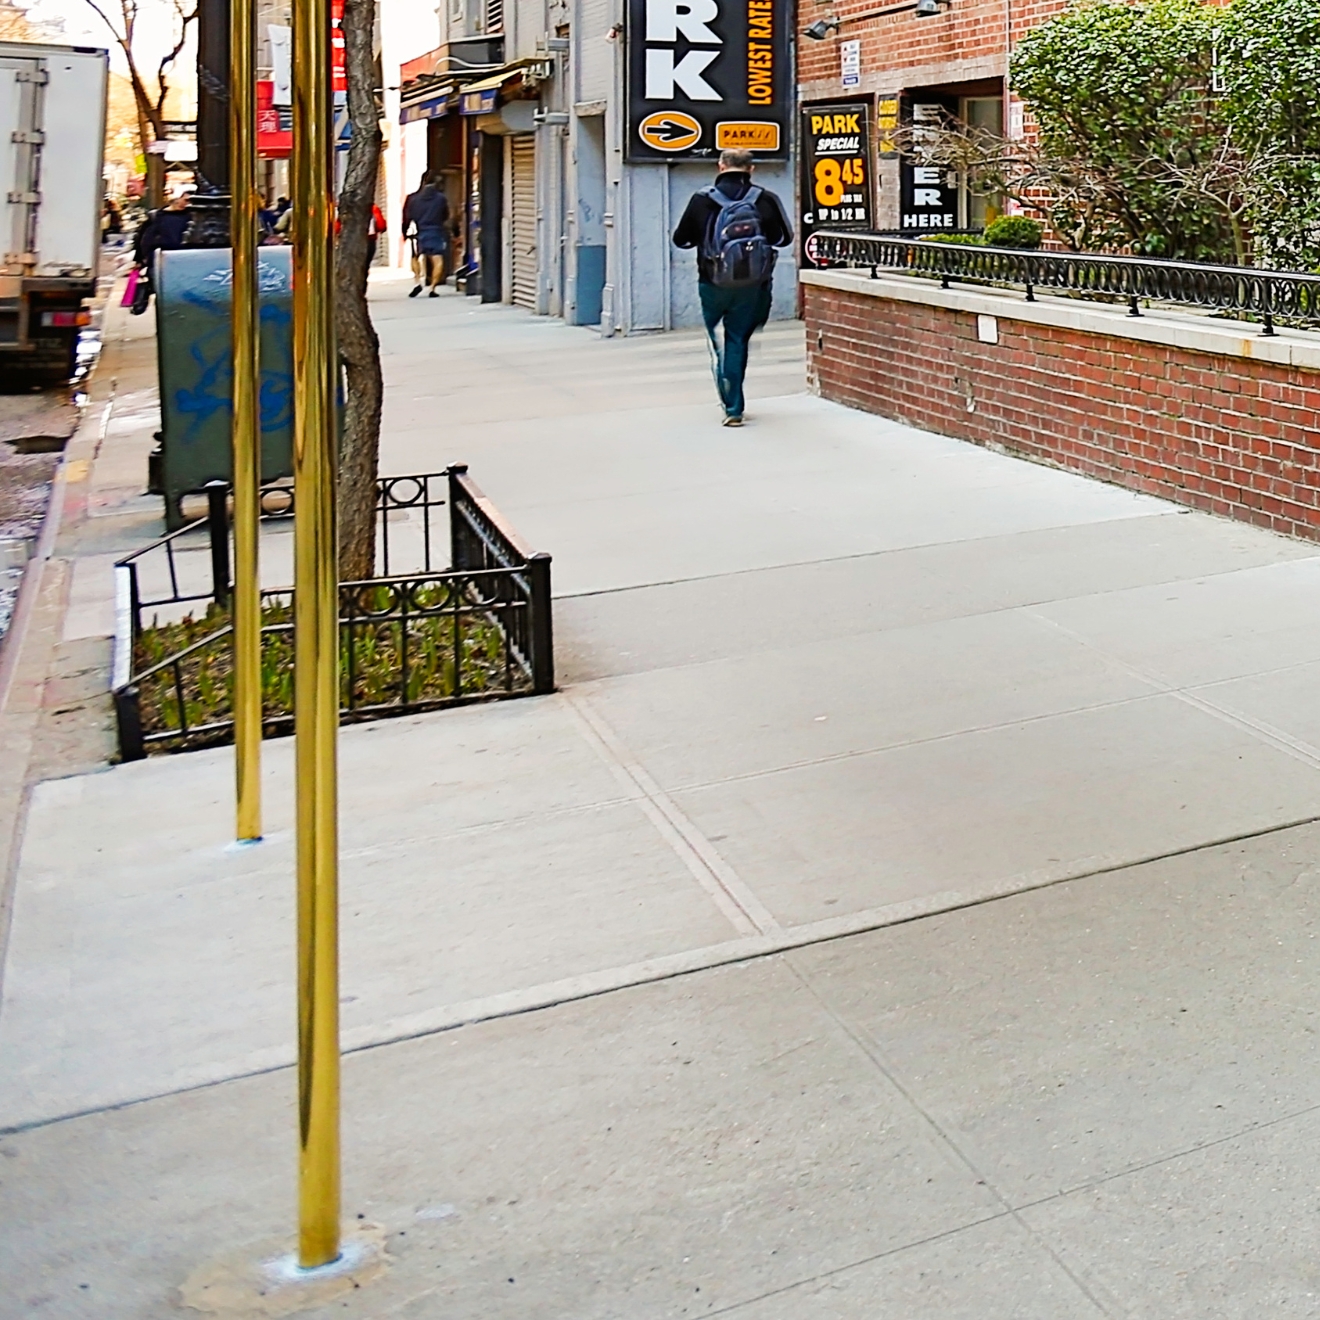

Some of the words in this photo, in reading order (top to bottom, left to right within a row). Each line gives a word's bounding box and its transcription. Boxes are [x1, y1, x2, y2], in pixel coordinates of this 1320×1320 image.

[747, 41, 773, 105] LOWEST
[811, 114, 861, 135] PARK
[816, 136, 860, 151] SPECIAL
[903, 213, 954, 228] HERE
